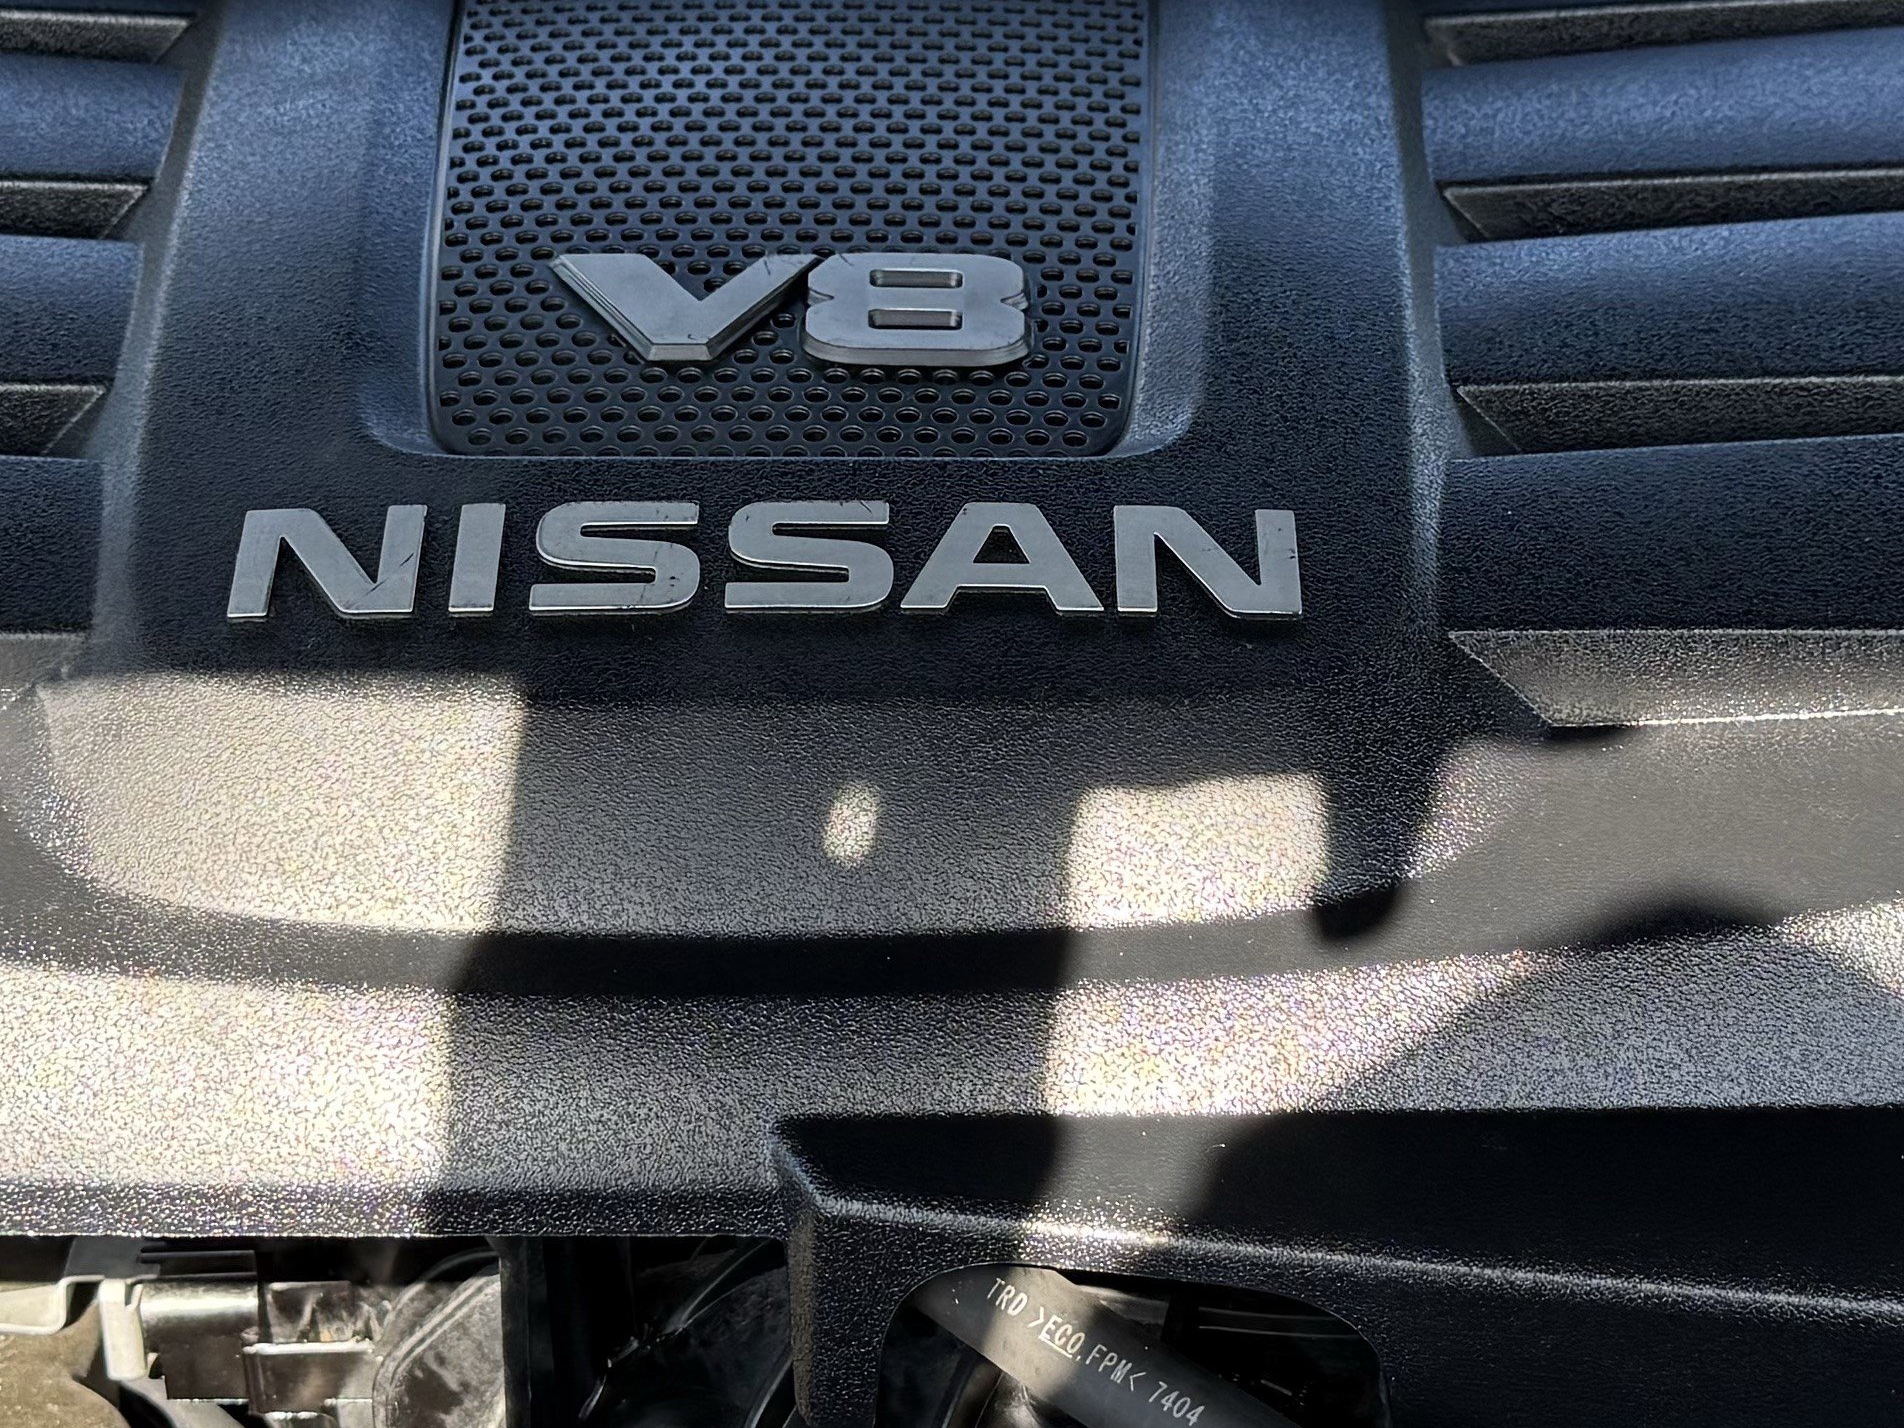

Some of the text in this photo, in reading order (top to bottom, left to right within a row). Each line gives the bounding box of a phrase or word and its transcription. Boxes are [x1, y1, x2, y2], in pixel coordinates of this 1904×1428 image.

[550, 251, 1032, 367] V8
[226, 500, 1303, 621] NISSAN
[987, 1278, 1028, 1316] TRD
[1148, 1381, 1205, 1426] 7404
